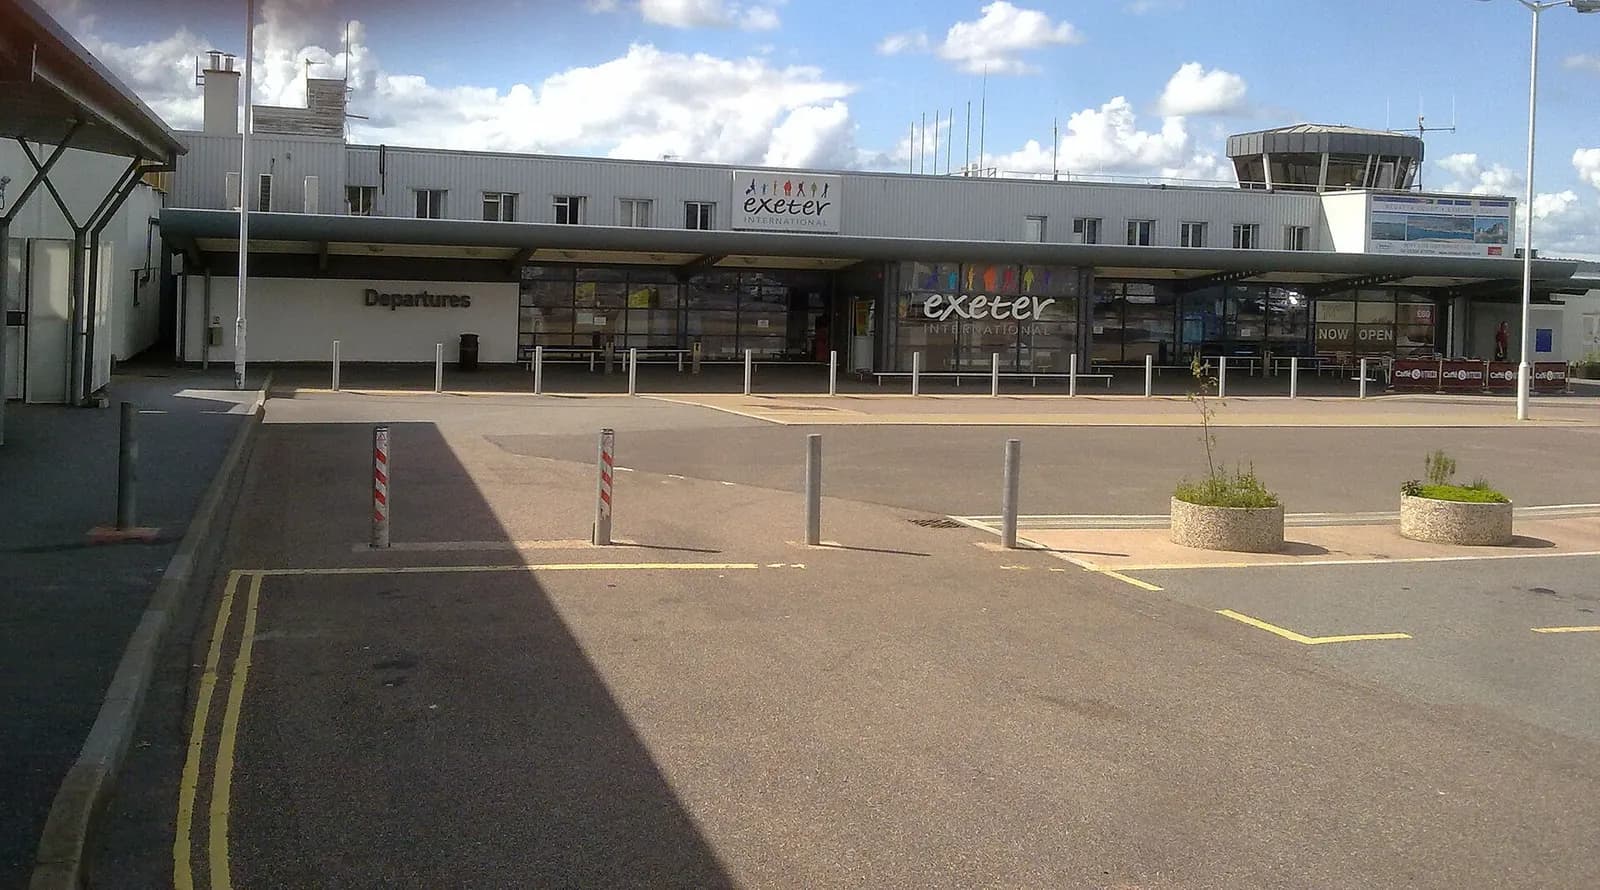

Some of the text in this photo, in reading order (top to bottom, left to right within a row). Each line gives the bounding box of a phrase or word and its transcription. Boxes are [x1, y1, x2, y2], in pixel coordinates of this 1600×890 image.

[743, 196, 831, 216] exeter
[743, 216, 828, 227] INTERNATIONAL
[364, 288, 471, 311] Departures
[923, 293, 1056, 322] exeter
[923, 323, 1051, 337] INTERNATIONAL
[1319, 328, 1393, 341] NOW OPEN
